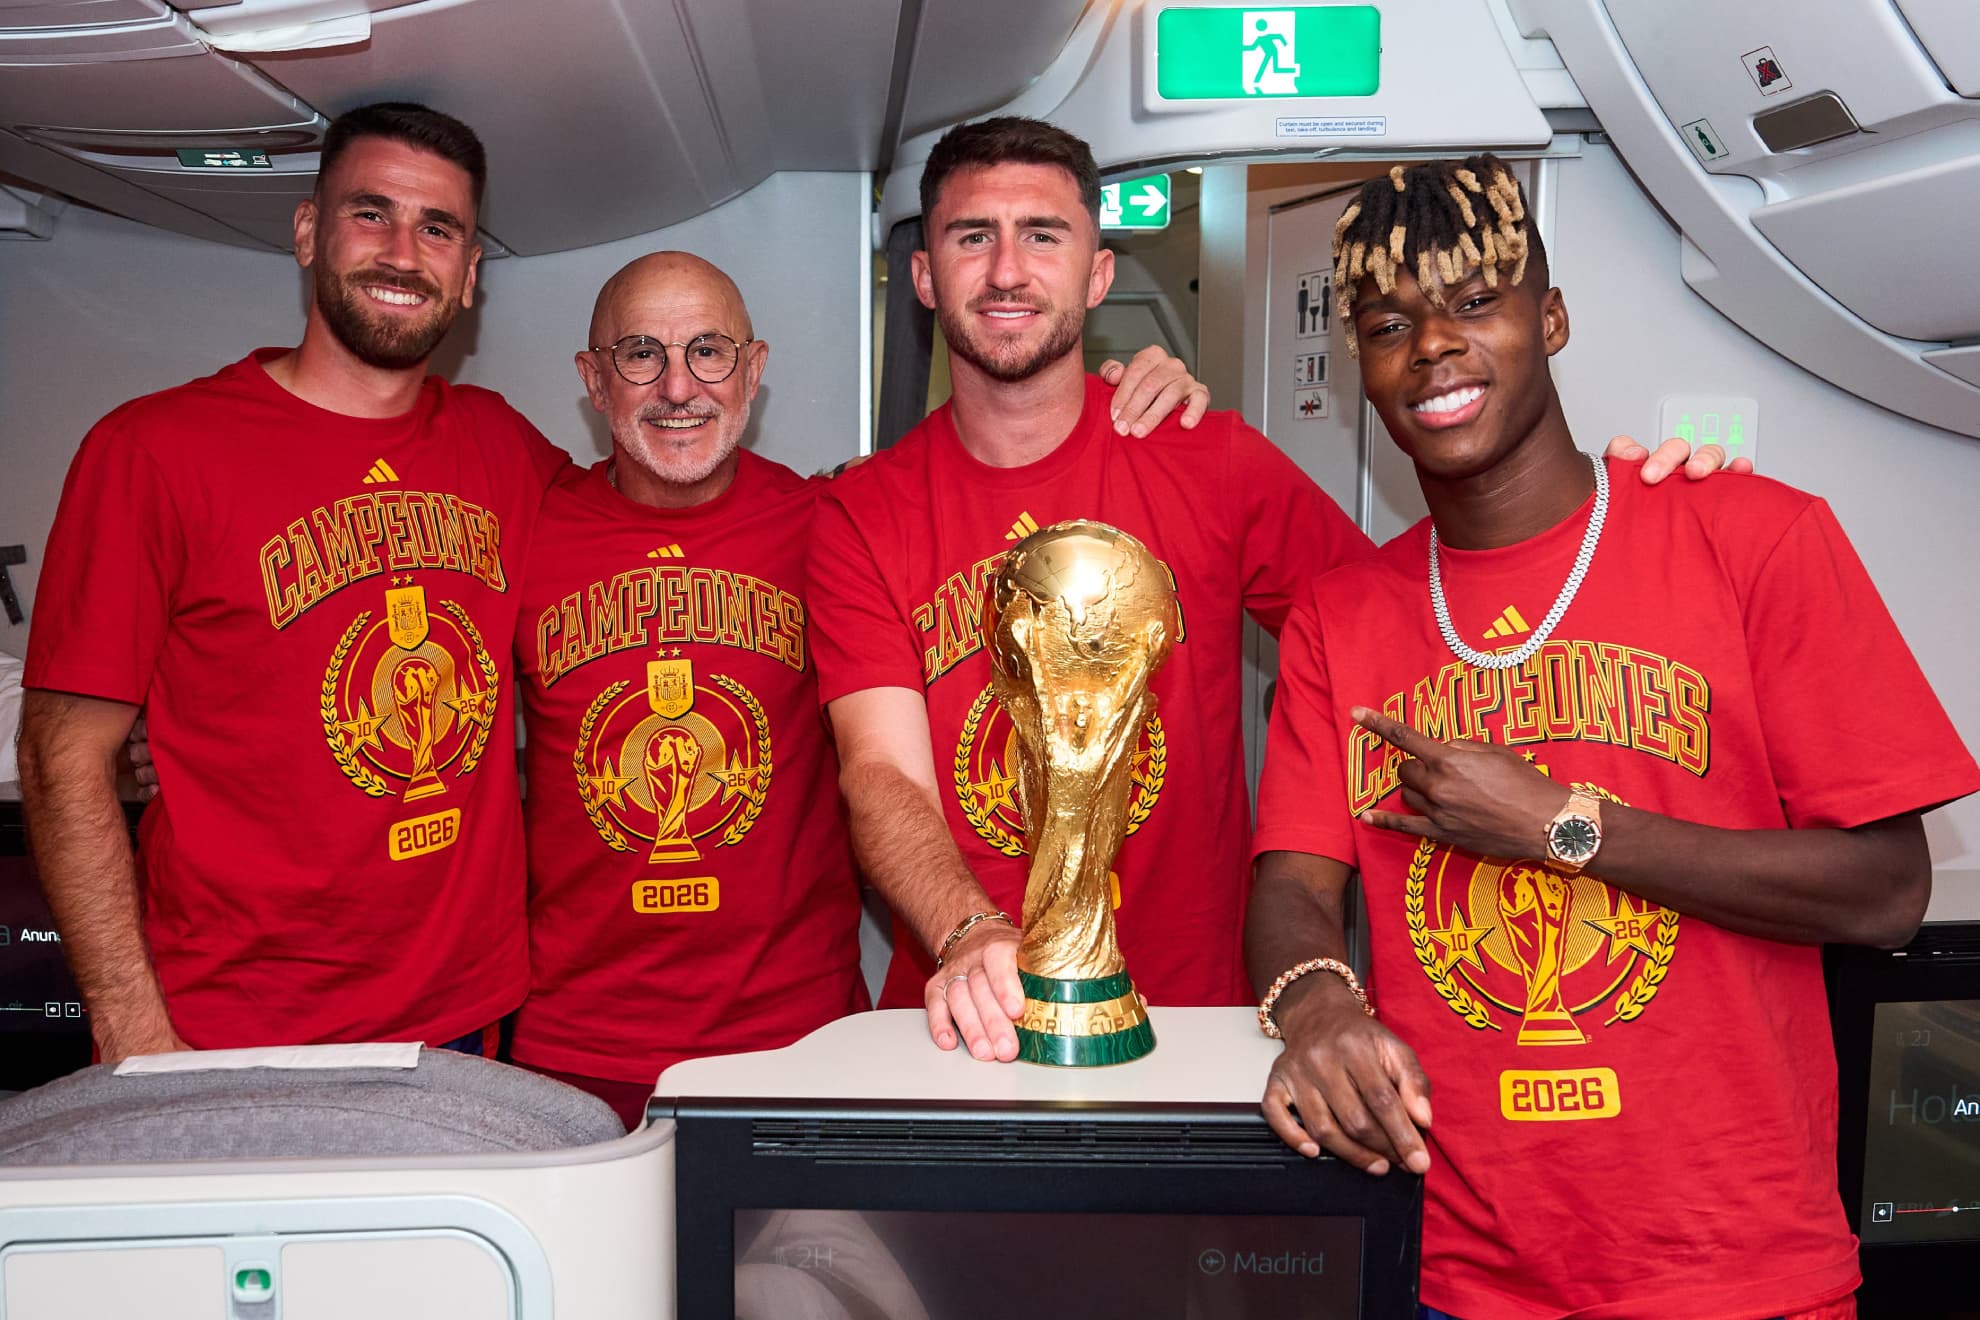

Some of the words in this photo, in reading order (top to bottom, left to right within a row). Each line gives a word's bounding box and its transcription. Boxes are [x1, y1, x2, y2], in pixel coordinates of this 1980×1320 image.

[260, 491, 507, 630] CAMPEONES
[537, 566, 806, 689] CAMPEONES
[459, 698, 477, 714] 26
[356, 721, 371, 738] 10
[1348, 640, 1711, 818] CAMPEONES
[601, 780, 615, 795] 10
[728, 773, 746, 788] 26
[988, 782, 1005, 800] 10
[397, 816, 454, 854] 2026
[642, 883, 709, 908] 2026
[1614, 919, 1641, 940] 26
[1451, 932, 1469, 952] 10
[1089, 1016, 1125, 1035] CUP
[1512, 1077, 1605, 1113] 2026
[798, 1246, 833, 1268] 2H
[1233, 1250, 1324, 1275] Madrid
